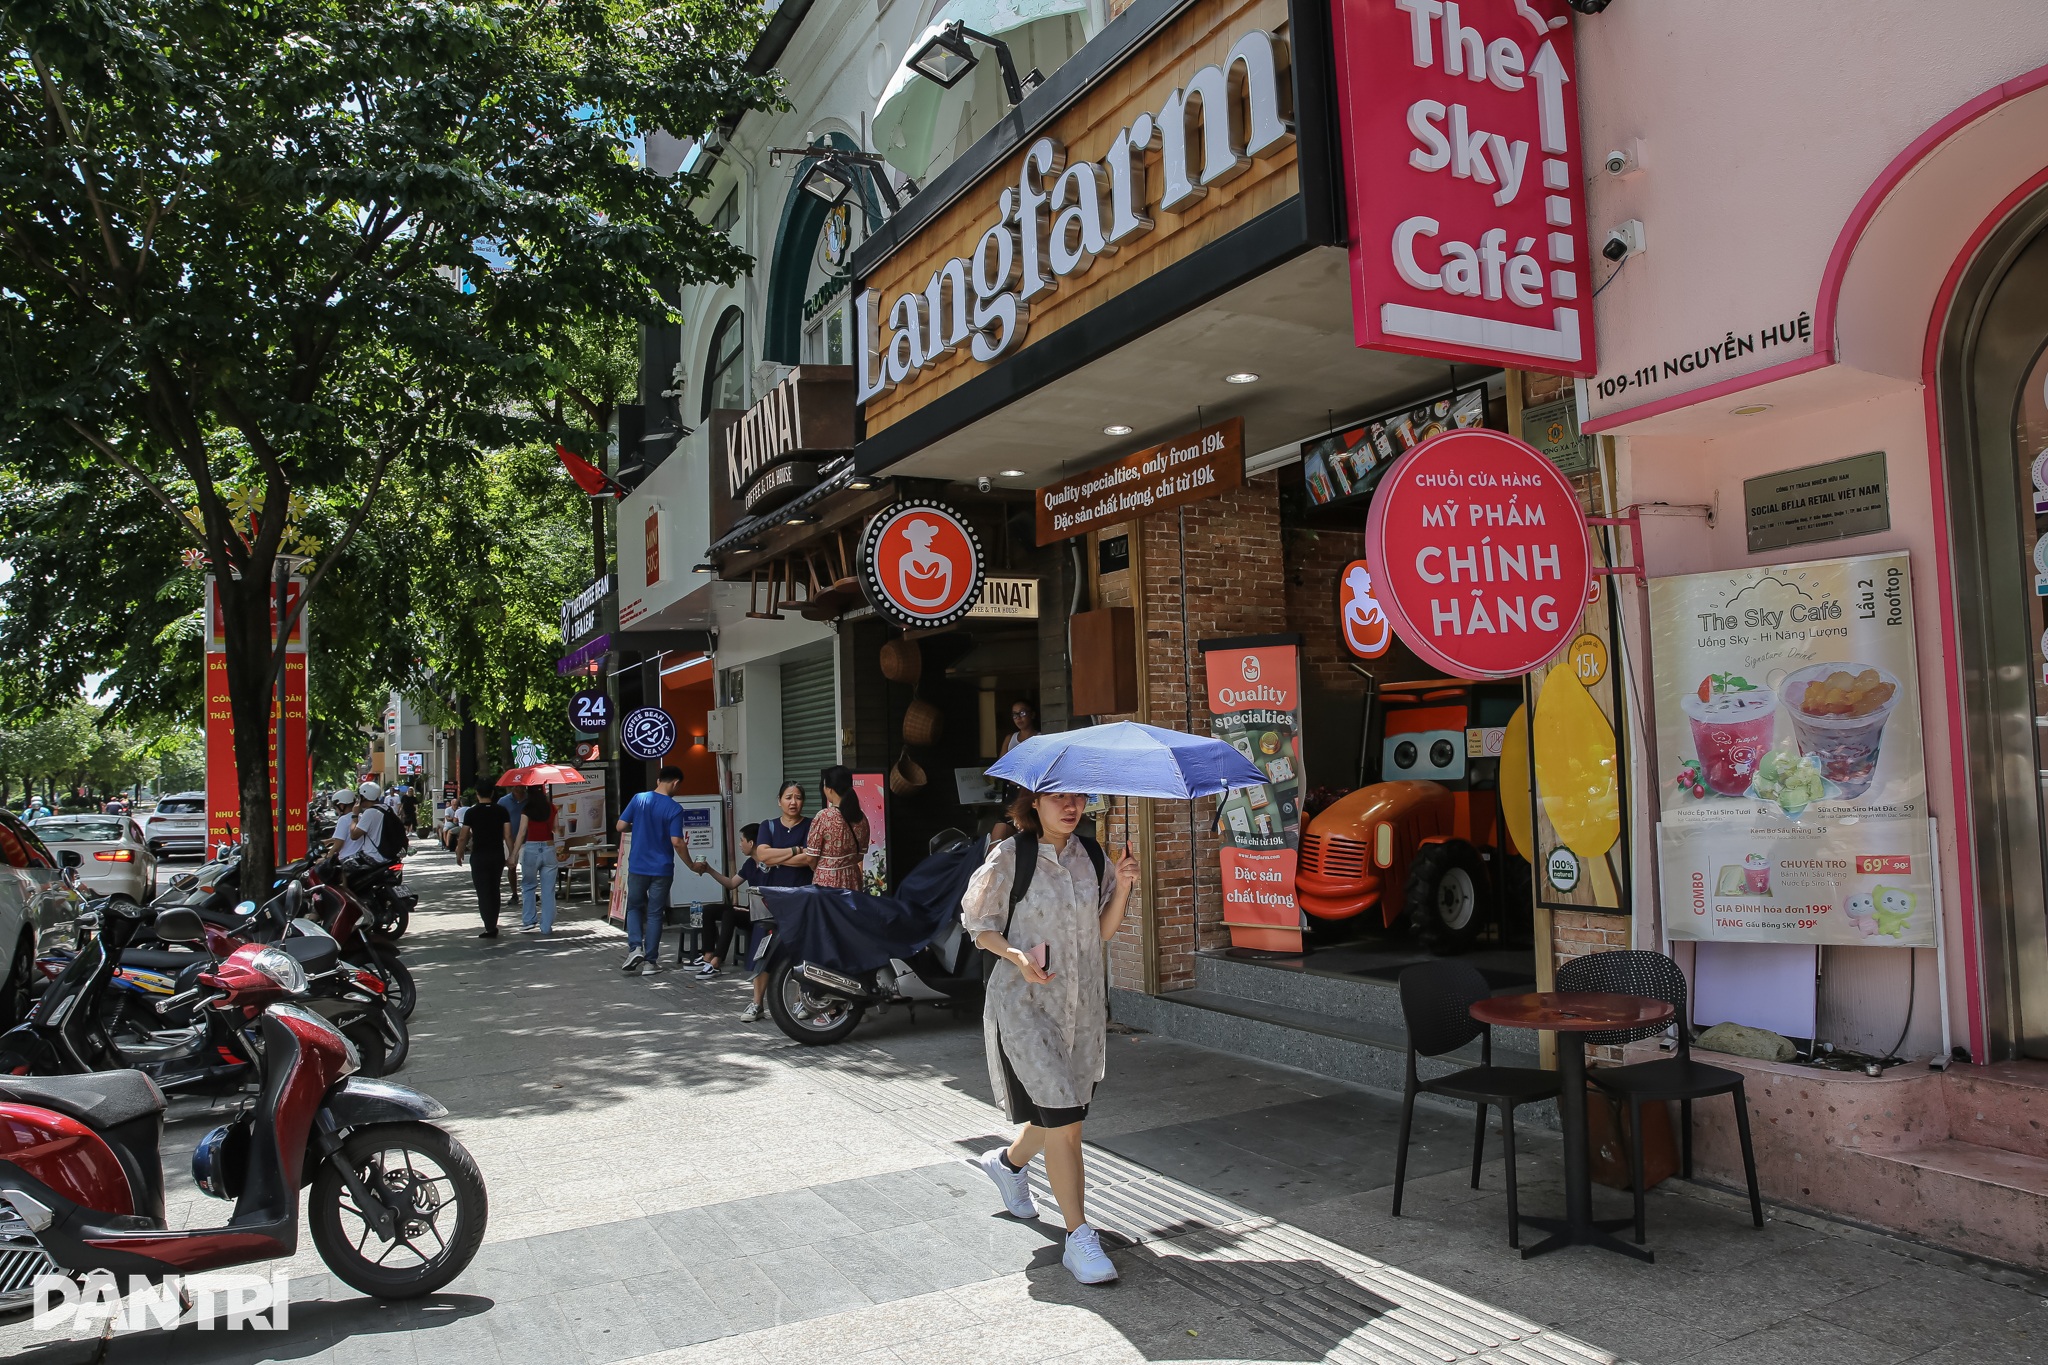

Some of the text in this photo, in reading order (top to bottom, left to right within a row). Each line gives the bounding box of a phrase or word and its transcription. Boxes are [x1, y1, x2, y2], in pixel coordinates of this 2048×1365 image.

[1395, 0, 1525, 92] The
[1406, 99, 1529, 207] Sky
[856, 29, 1296, 405] Langfarm
[1392, 216, 1544, 309] Café
[1597, 311, 1811, 400] 109-111 NGUYỄN HUỆ
[725, 366, 802, 499] KATINAT
[1044, 431, 1225, 511] Quality specialties, only from 19k
[1415, 469, 1542, 487] CHUỖI CỬA HÀNG
[745, 466, 792, 510] COFFEE & TEA HOUSE
[1054, 464, 1215, 532] Đặc sản chất lượng, chỉ từ 19k
[1751, 503, 1779, 517] SOCIAL
[1808, 494, 1836, 506] RETAIL
[1838, 487, 1856, 501] VIỆT
[1858, 484, 1880, 496] NAM
[1422, 494, 1546, 527] MỸ PHẨM
[1416, 536, 1561, 584] CHÍNH
[595, 573, 609, 601] BEAN
[980, 582, 1033, 609] TINAT
[1856, 579, 1876, 620] Lầu 2
[1884, 567, 1903, 626] Rooftop
[1430, 588, 1560, 636] HÃNG
[1697, 600, 1842, 632] The Sky Café
[1697, 635, 1726, 649] Uống
[1729, 635, 1750, 647] Sky
[1775, 630, 1805, 642] Năng
[1809, 625, 1848, 639] Lượng
[1576, 653, 1600, 678] 15k
[1744, 647, 1817, 669] Signature Drink
[577, 697, 606, 716] 24
[1218, 684, 1287, 707] Quality
[210, 711, 231, 721] THẬT
[580, 717, 607, 727] Hours
[627, 711, 665, 738] COFFEE BEAN
[1214, 709, 1293, 730] specialties
[642, 747, 657, 755] TEA
[657, 736, 671, 752] LEAF
[1235, 835, 1248, 845] Giá
[1260, 836, 1268, 846] từ
[1270, 835, 1284, 846] 19k
[1234, 866, 1283, 885] Đặc sản
[1552, 859, 1574, 870] 100%
[1554, 870, 1573, 879] natural
[1780, 858, 1847, 871] CHUYỆN TRÒ
[1863, 858, 1889, 872] 69K
[1226, 888, 1295, 909] chất lượng
[1691, 872, 1706, 916] COMBO
[1715, 903, 1833, 914] GIA ĐÌNH hóa đơn 199K
[1716, 918, 1743, 930] TẶNG
[1797, 919, 1818, 929] 99K
